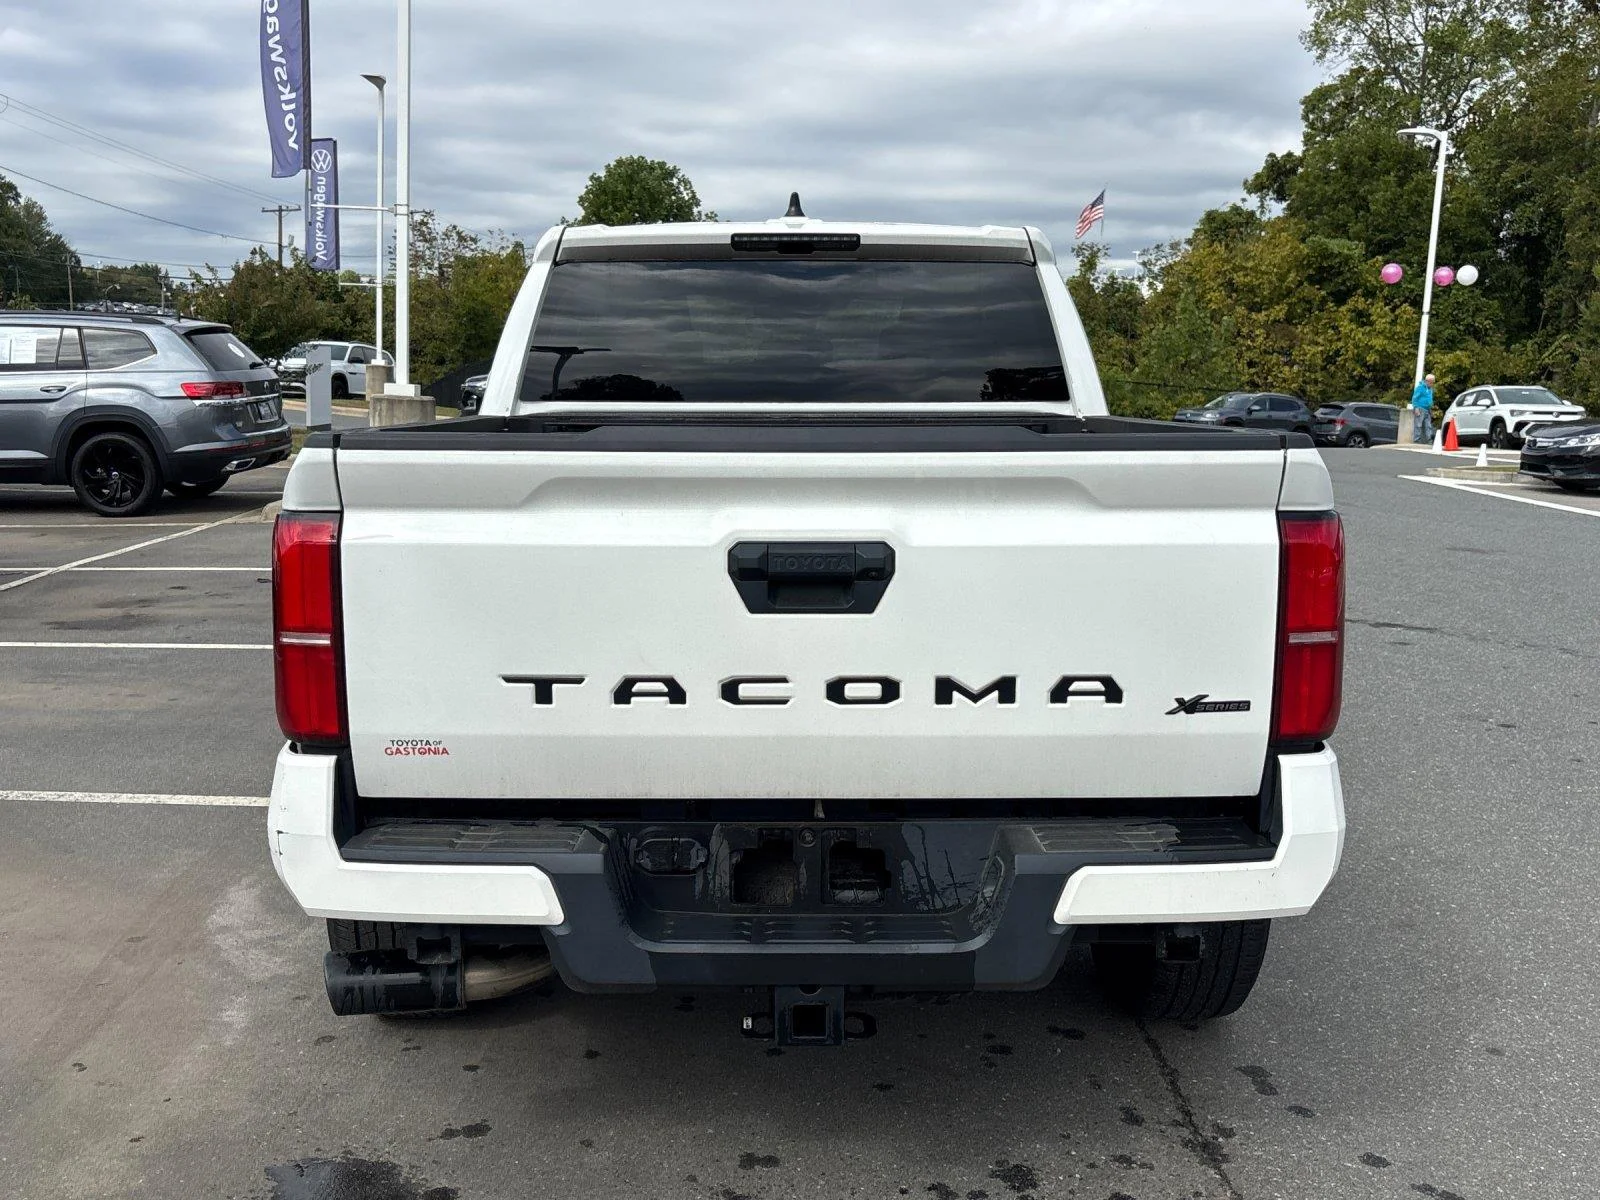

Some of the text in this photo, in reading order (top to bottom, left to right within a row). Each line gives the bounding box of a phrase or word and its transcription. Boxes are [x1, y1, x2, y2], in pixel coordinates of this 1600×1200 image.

[774, 556, 850, 570] TOYOTA
[500, 675, 1123, 706] TACOMA
[389, 739, 432, 747] TOYOTA
[384, 747, 450, 756] GASTONIA
